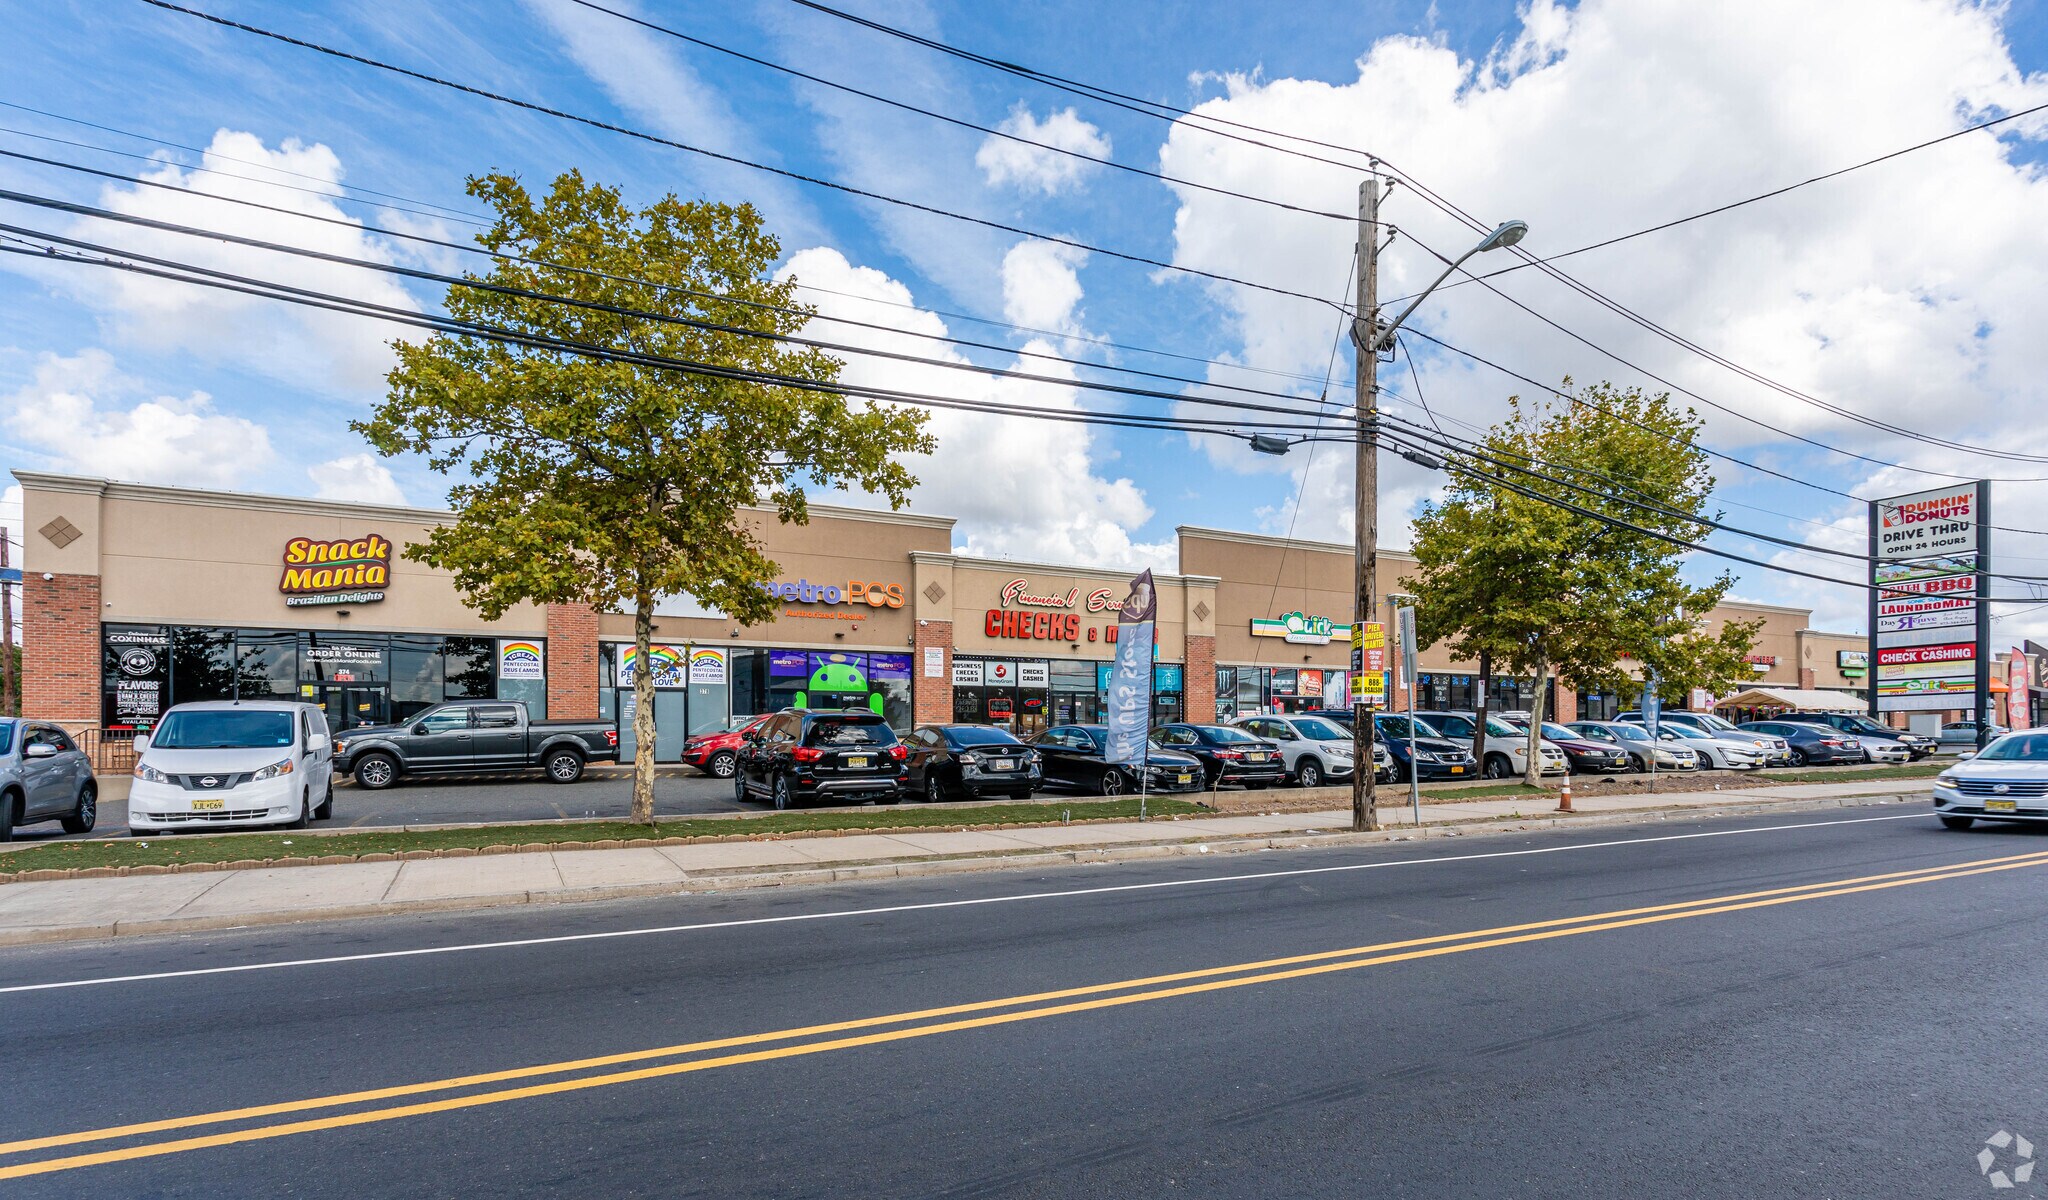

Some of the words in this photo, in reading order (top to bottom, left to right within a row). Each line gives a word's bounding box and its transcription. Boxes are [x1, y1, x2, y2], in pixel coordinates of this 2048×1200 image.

[1905, 494, 1973, 514] DUNKIN'
[1905, 505, 1970, 524] DONUTS
[1883, 528, 1924, 543] DRIVE
[1930, 521, 1969, 536] THRU
[286, 537, 387, 563] Snack
[1887, 544, 1912, 554] OPEN
[1915, 542, 1928, 550] 24
[1931, 537, 1967, 548] HOURS
[282, 564, 386, 589] Mania
[1001, 578, 1080, 608] Financial
[1925, 577, 1973, 594] BBQ
[286, 594, 338, 606] Brazilian
[339, 592, 384, 603] Delights
[847, 580, 905, 609] PCS
[1881, 595, 1971, 615] LAUNDROMAT
[785, 609, 835, 620] Authorized
[837, 612, 867, 621] Dealer
[985, 608, 1081, 642] CHECKS
[1087, 627, 1097, 642] &
[1367, 623, 1381, 632] PIER
[110, 635, 167, 644] COXINHAS
[1364, 631, 1384, 640] DRIVERS
[1364, 638, 1385, 650] WANTED
[344, 651, 381, 659] ONLINE
[508, 652, 534, 661] IGREJA
[1880, 652, 1918, 663] CHECK
[1921, 648, 1972, 661] CASHING
[697, 659, 719, 667] IGREJA
[118, 680, 160, 690] FLAVORS
[1025, 699, 1041, 707] OPEN
